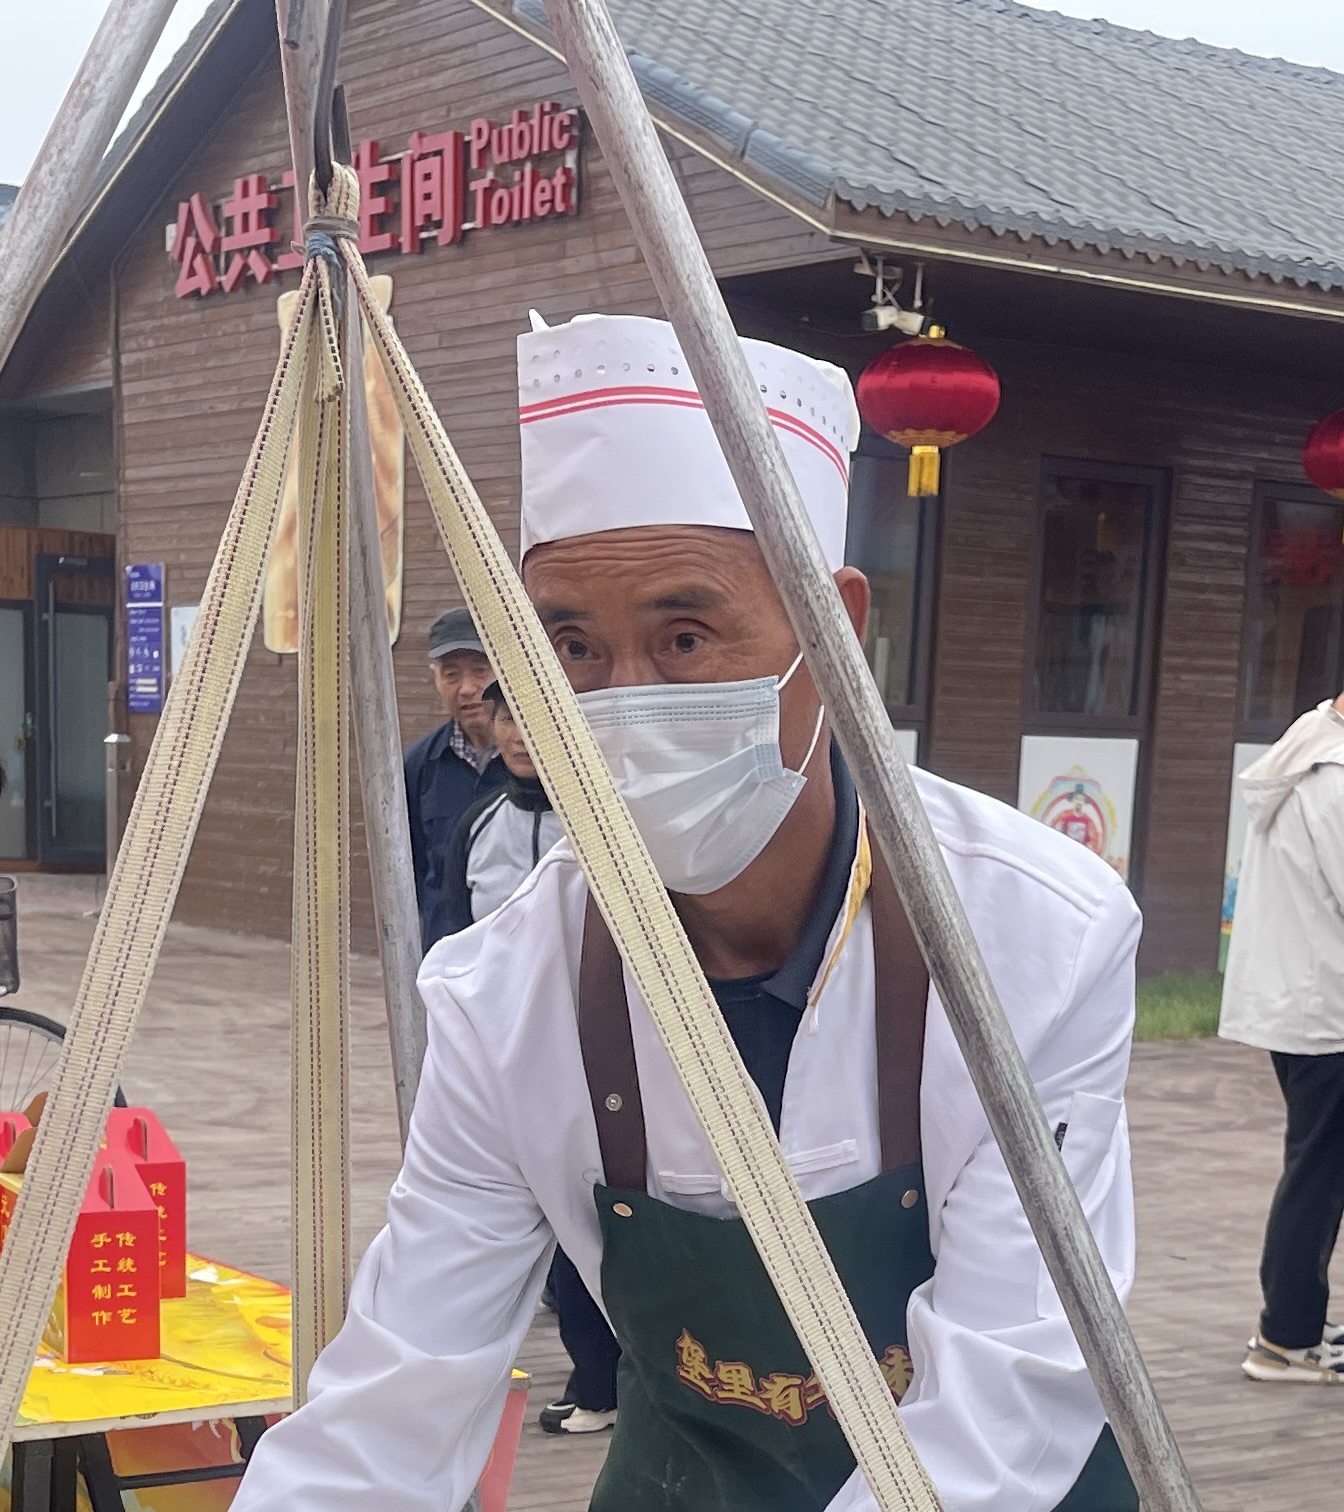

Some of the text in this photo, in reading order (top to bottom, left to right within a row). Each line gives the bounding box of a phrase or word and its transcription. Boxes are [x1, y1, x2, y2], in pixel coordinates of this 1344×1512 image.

[470, 101, 575, 169] Public
[469, 165, 574, 228] Toilet
[90, 1232, 112, 1325] 手工制作
[116, 1231, 137, 1325] 传统工艺
